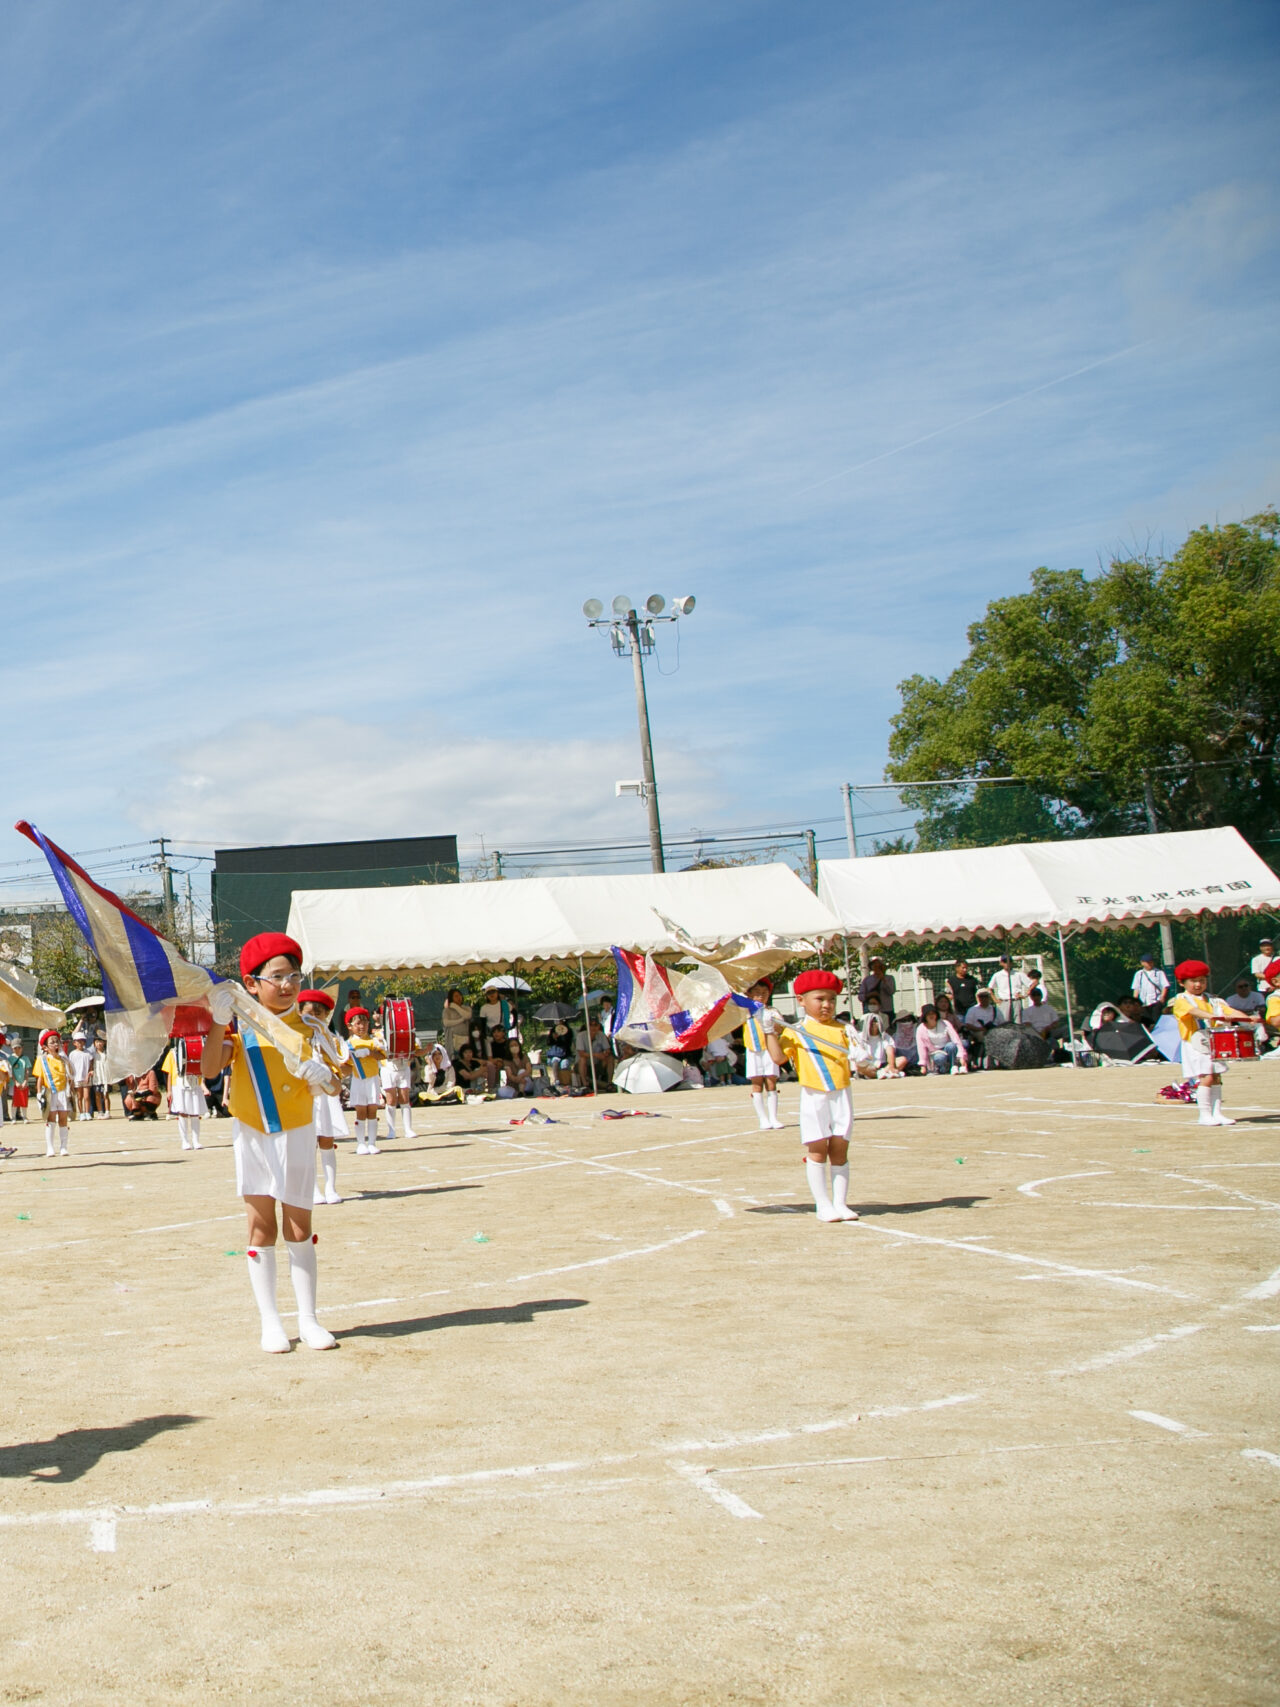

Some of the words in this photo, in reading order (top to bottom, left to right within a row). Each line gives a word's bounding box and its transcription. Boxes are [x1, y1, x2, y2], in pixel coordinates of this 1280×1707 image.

[1076, 880, 1252, 904] 正光乳児保育園
